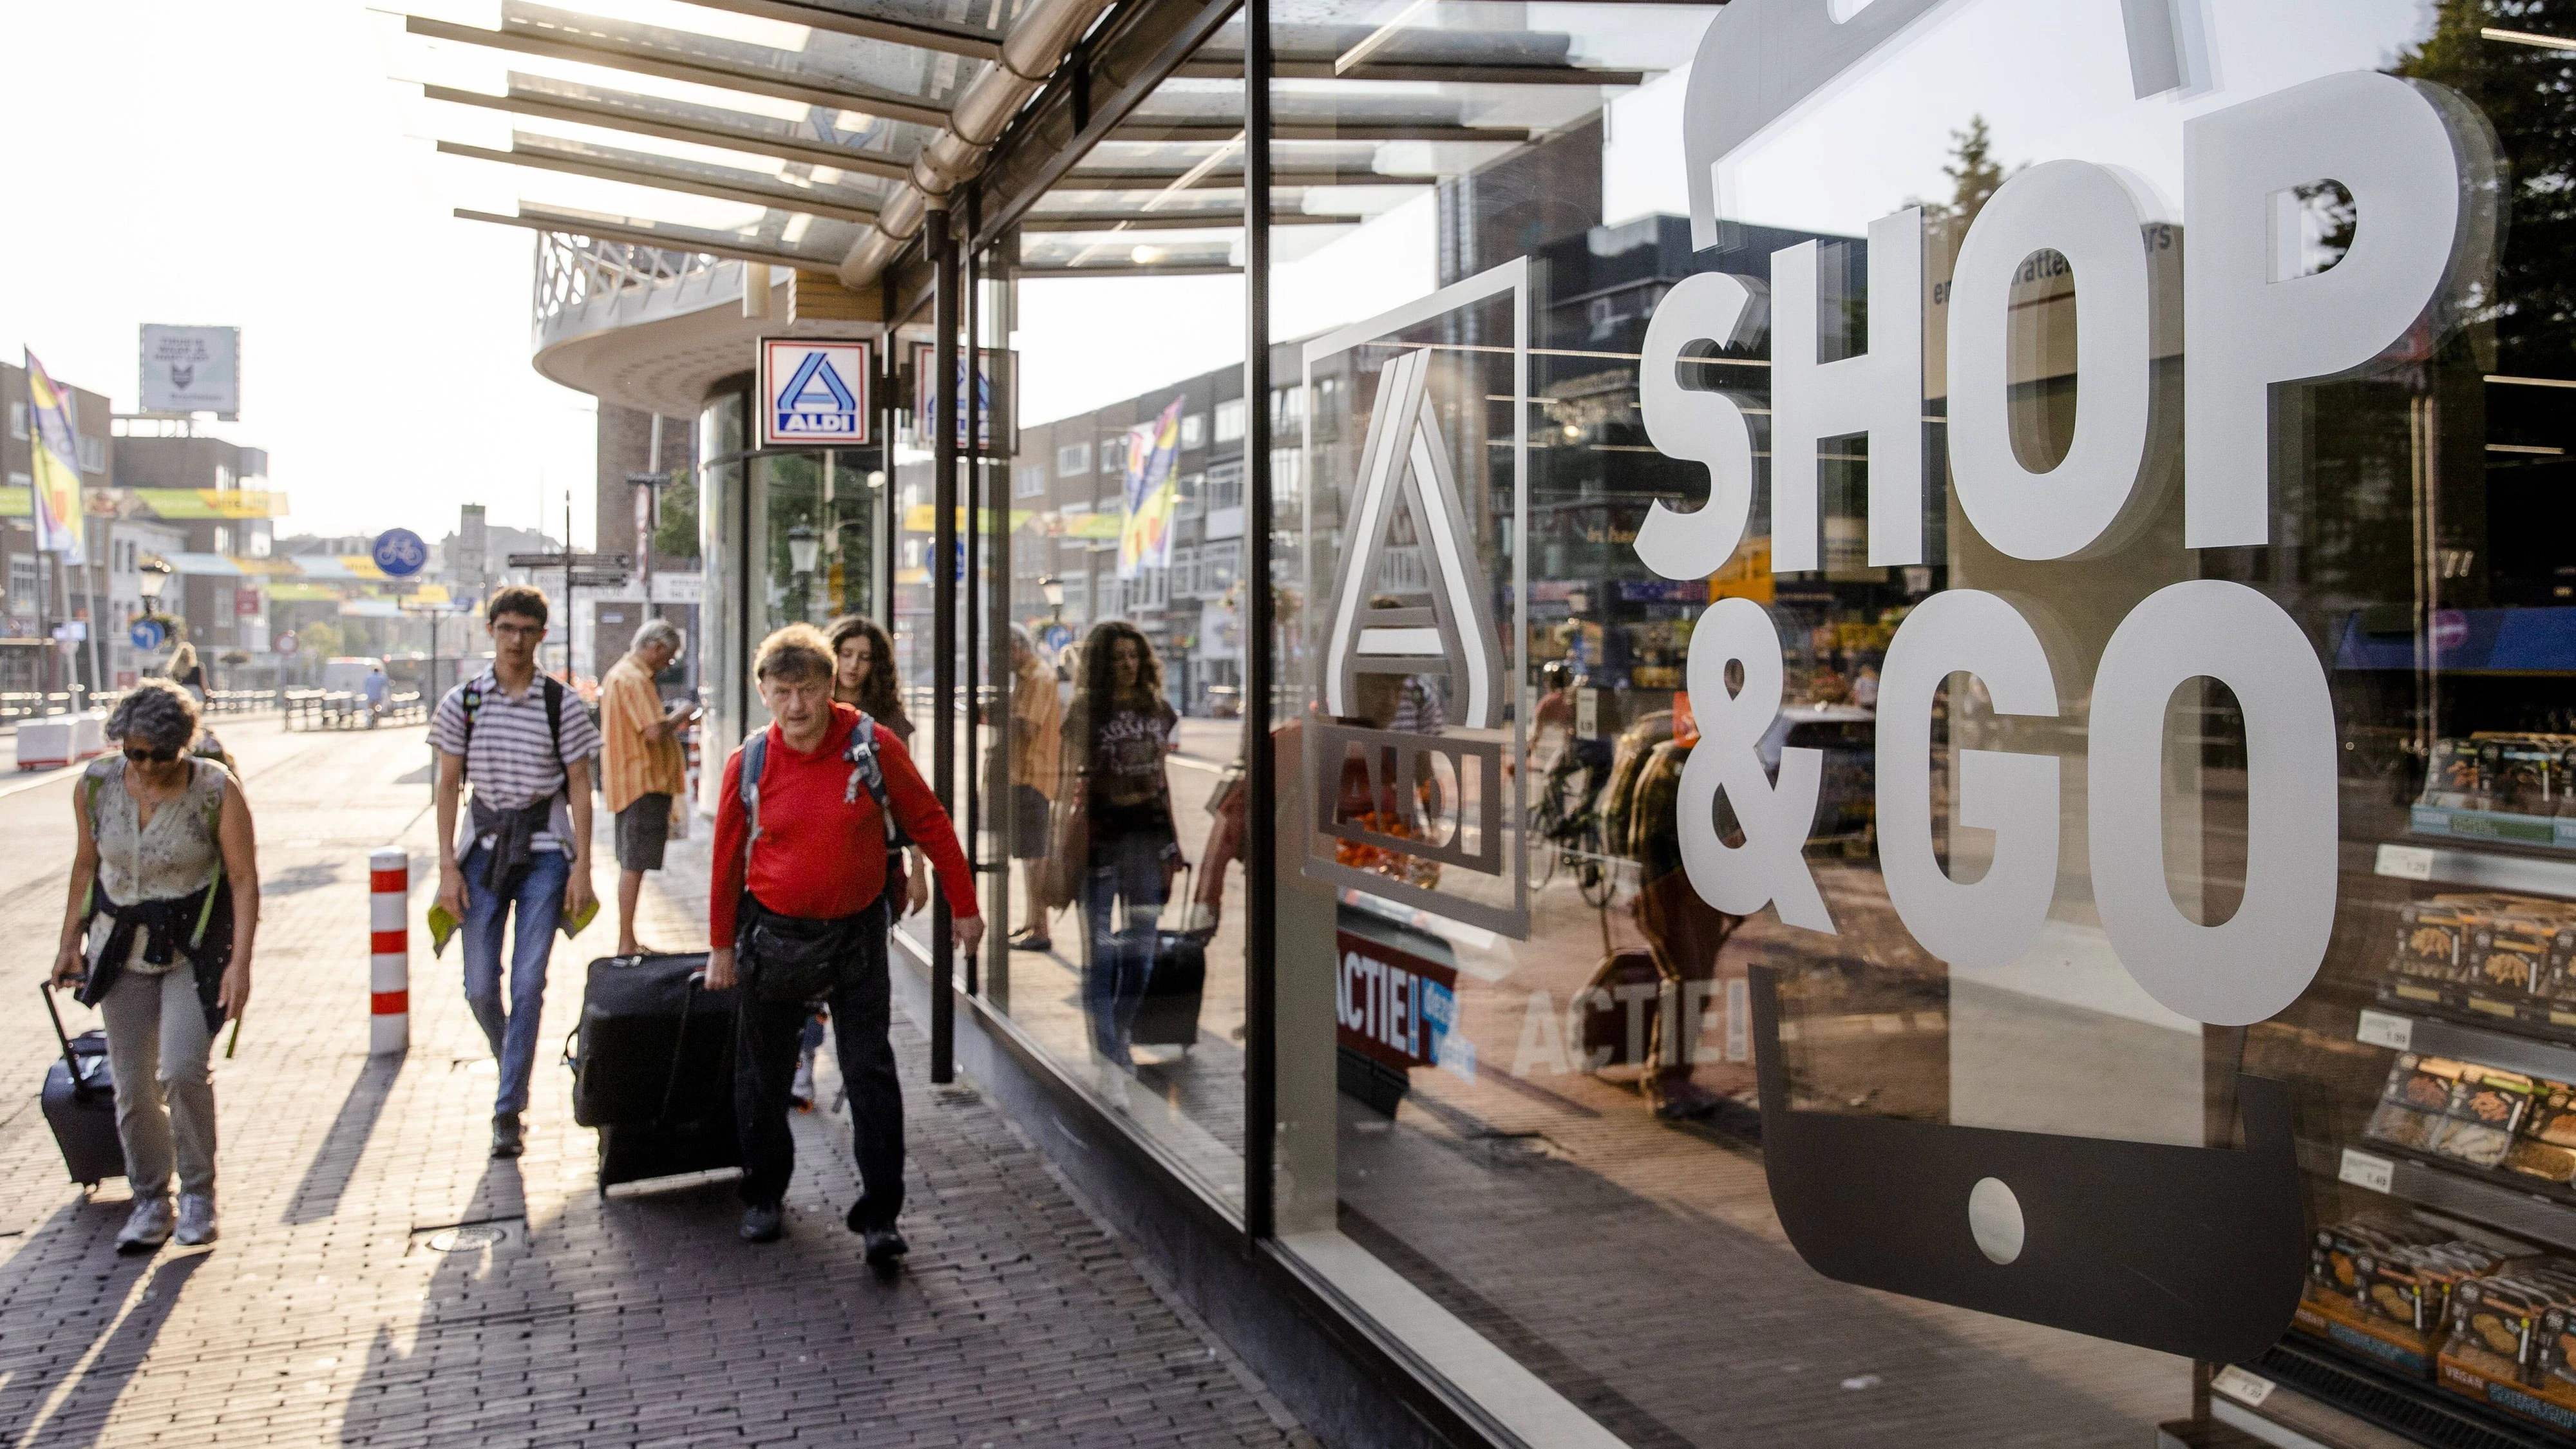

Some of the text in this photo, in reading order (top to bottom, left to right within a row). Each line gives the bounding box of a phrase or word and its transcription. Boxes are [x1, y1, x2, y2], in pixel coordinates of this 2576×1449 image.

[1633, 71, 2458, 581] SHOP
[784, 413, 850, 431] ALDI
[1332, 741, 1481, 857] ALDI
[1676, 579, 2338, 1027] & GO
[1511, 978, 1748, 1077] ACTIE!
